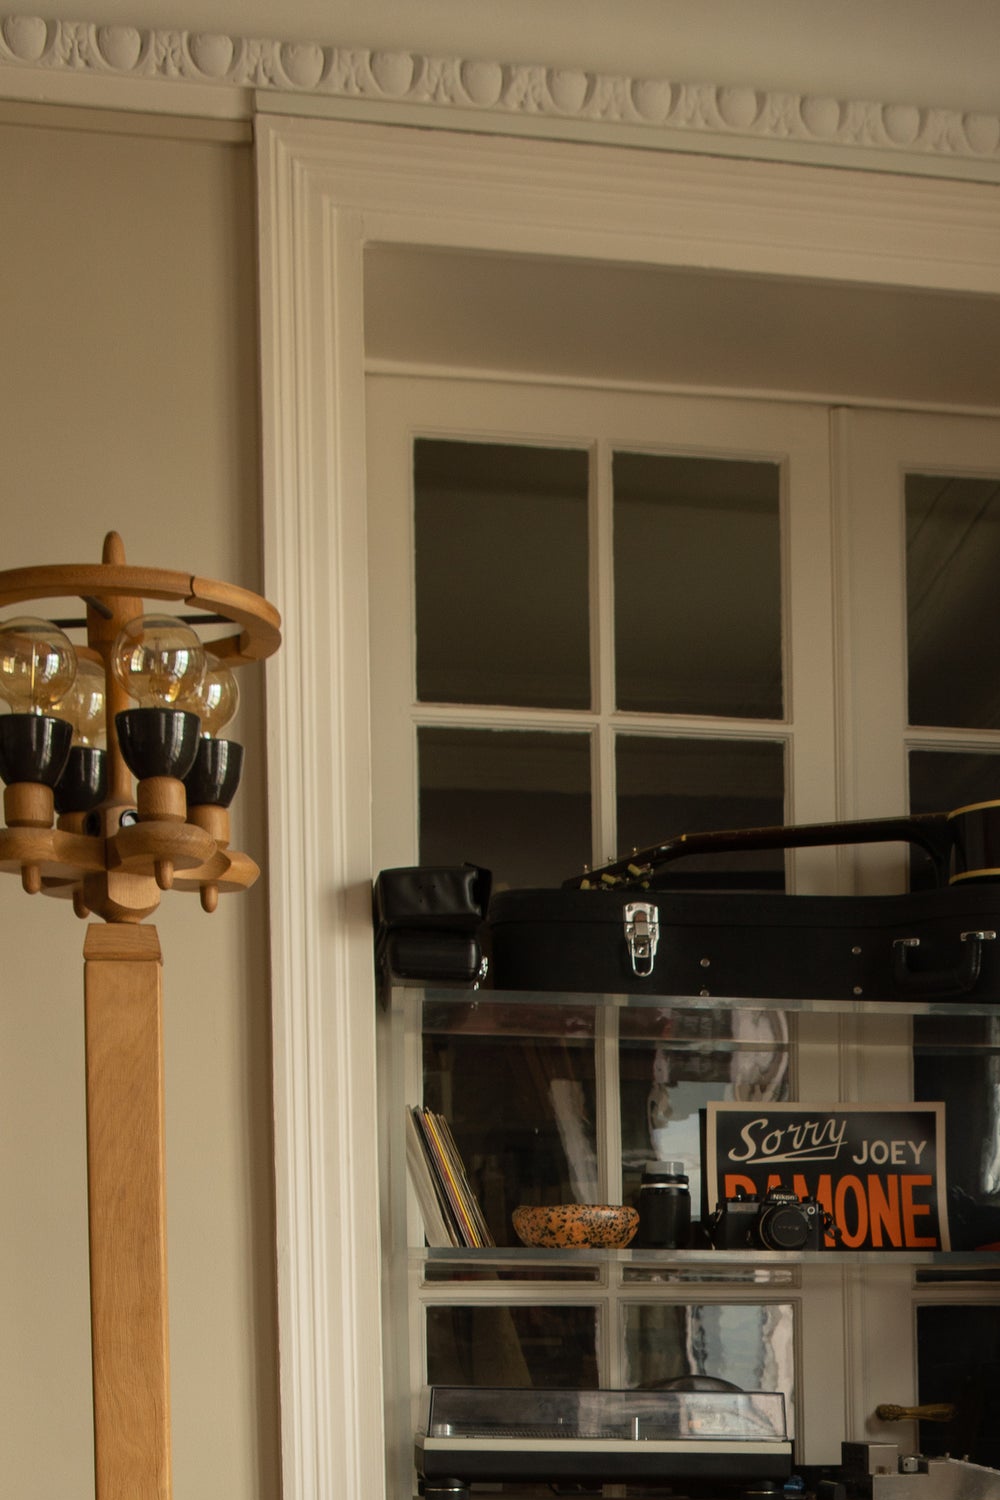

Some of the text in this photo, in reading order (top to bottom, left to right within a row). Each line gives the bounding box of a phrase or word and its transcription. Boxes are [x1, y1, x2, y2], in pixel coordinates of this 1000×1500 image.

[728, 1118, 927, 1165] Sorry JOEY
[724, 1174, 937, 1248] MONE
[772, 1193, 796, 1201] Nikon
